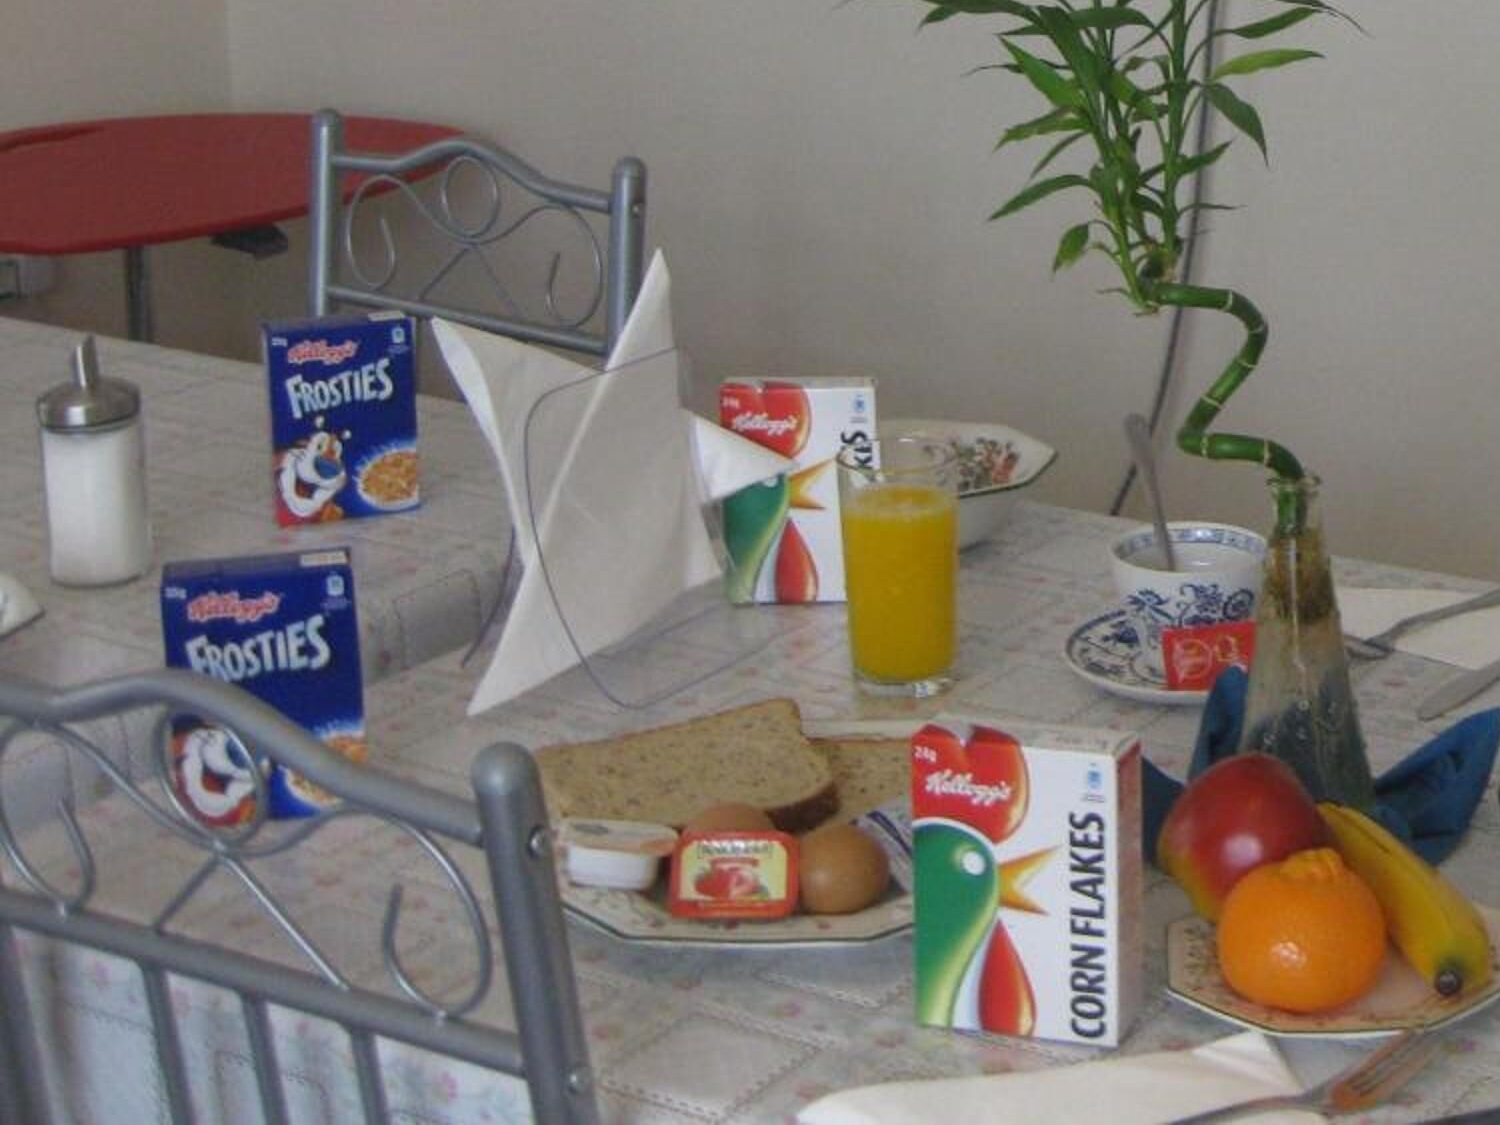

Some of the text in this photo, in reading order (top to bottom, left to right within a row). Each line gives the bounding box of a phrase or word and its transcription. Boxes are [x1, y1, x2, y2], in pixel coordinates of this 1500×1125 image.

[285, 358, 393, 419] FROSTIES
[185, 614, 331, 684] FROSTIES
[925, 768, 1013, 807] Kellogg's
[1068, 811, 1106, 938] FLAKES
[1070, 942, 1107, 1039] CORN
